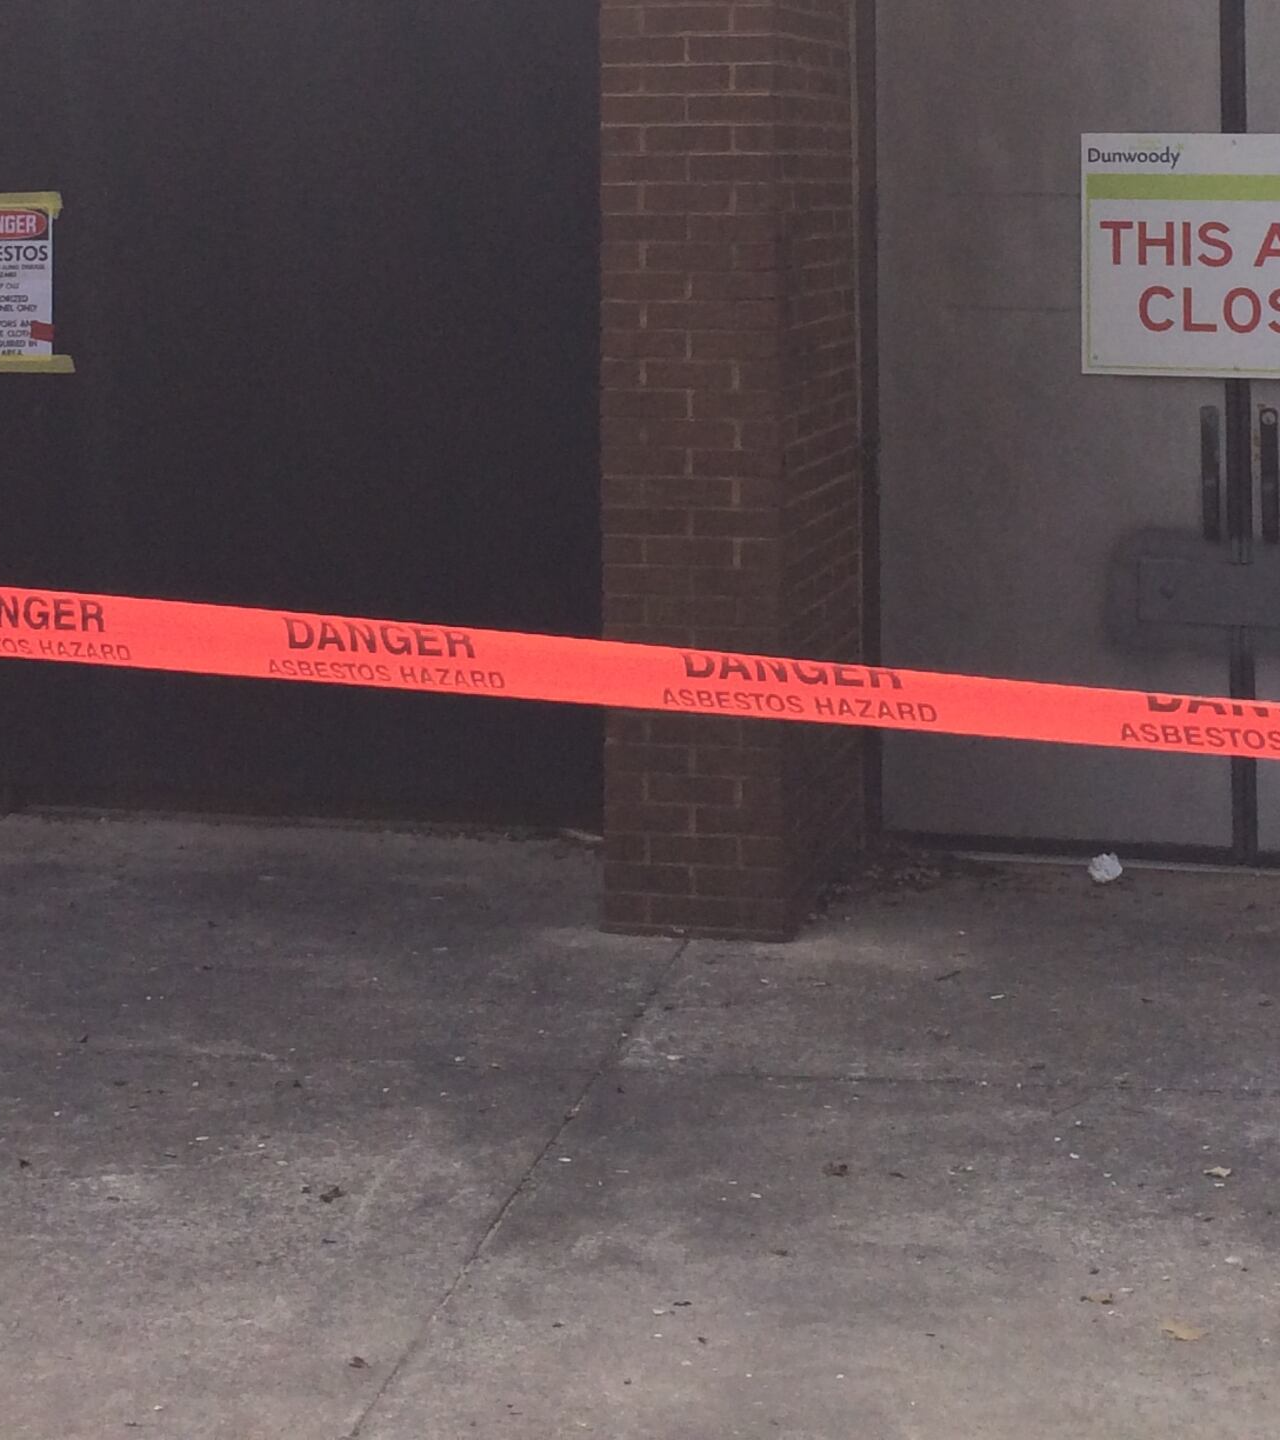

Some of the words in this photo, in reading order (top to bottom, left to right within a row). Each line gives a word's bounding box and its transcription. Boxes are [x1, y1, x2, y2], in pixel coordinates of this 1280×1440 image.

[1087, 145, 1181, 170] Dunwoody
[1100, 220, 1233, 267] THIS
[42, 640, 133, 661] HAZARD
[283, 617, 476, 659] DANGER
[269, 658, 392, 683] ASBESTOS
[400, 665, 506, 690] HAZARD
[663, 687, 805, 715] ASBESTOS
[815, 696, 939, 724] HAZARD
